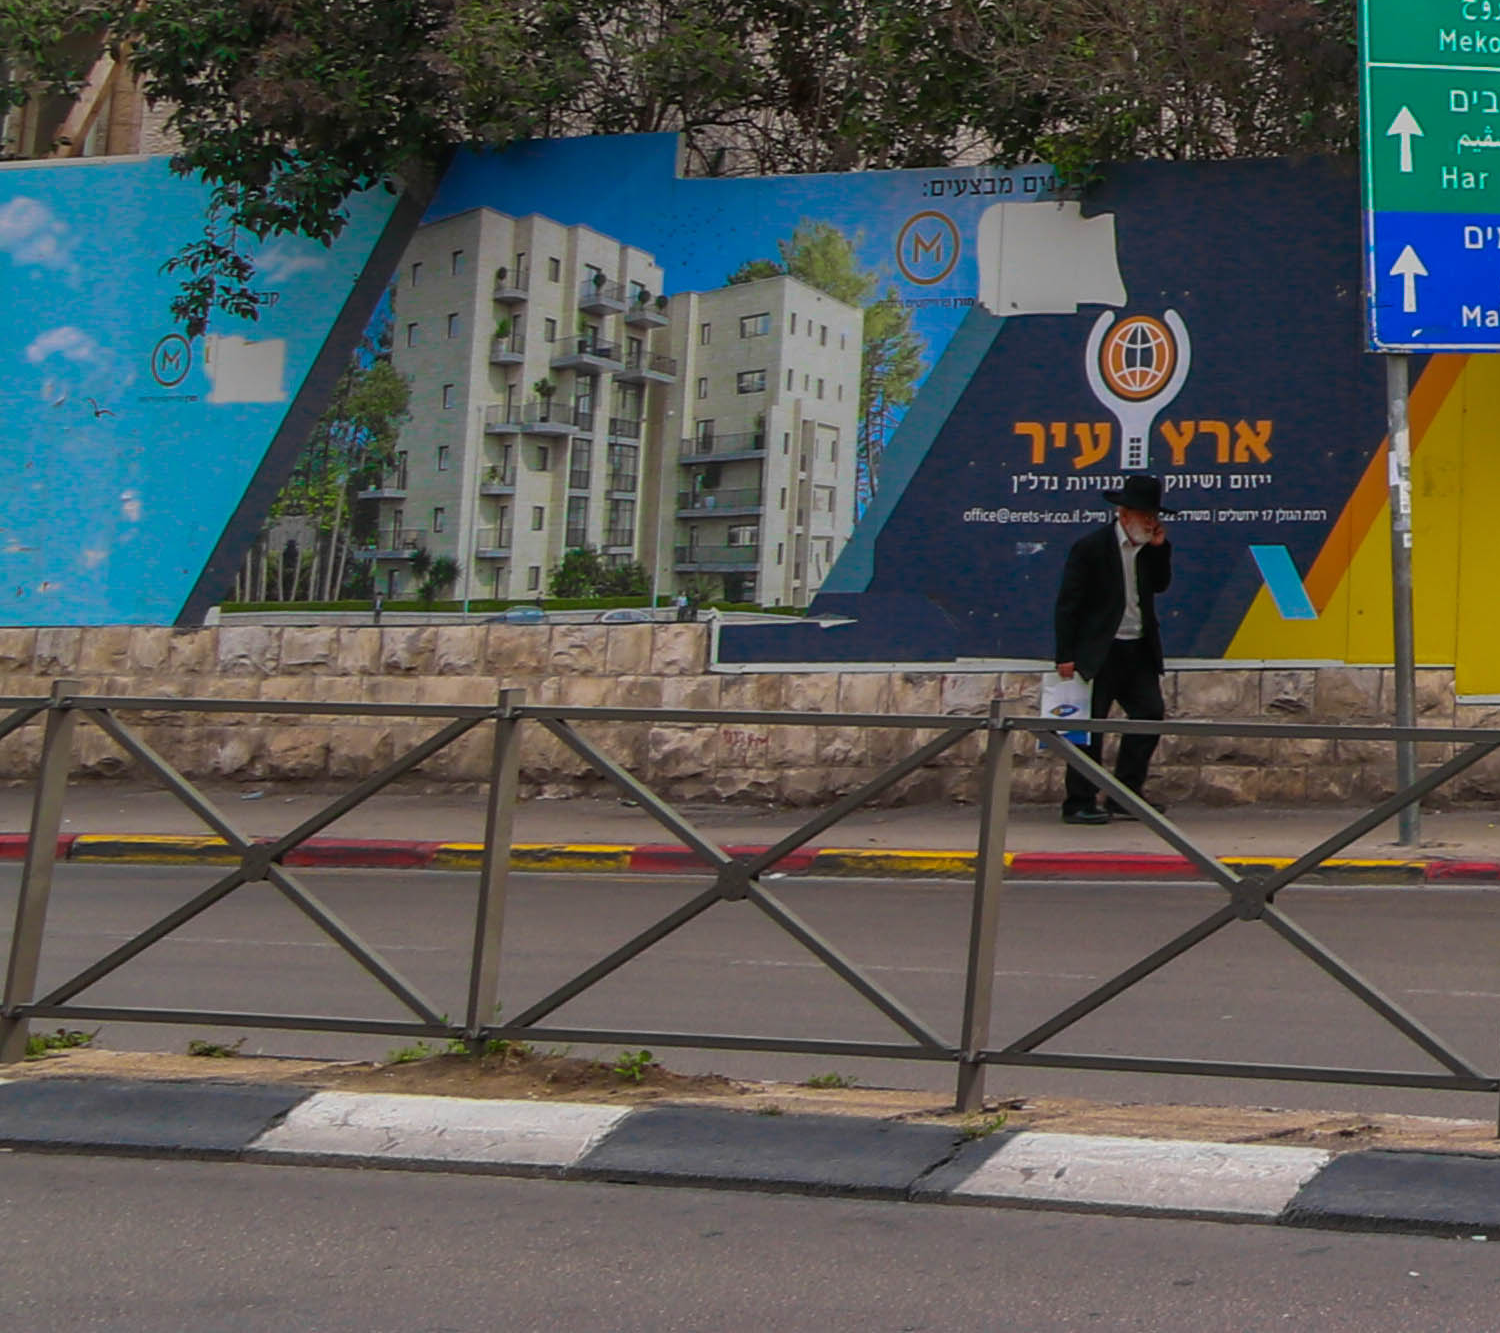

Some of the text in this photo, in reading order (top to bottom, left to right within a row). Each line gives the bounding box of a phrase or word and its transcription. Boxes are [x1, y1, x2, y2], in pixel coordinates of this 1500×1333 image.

[922, 175, 1013, 198] מבצעים:
[1441, 166, 1489, 191] Har
[1013, 419, 1273, 470] ארץ עיר
[1011, 473, 1059, 494] נדל"ן
[1164, 473, 1222, 492] ושיווק
[1229, 473, 1272, 491] ייזום
